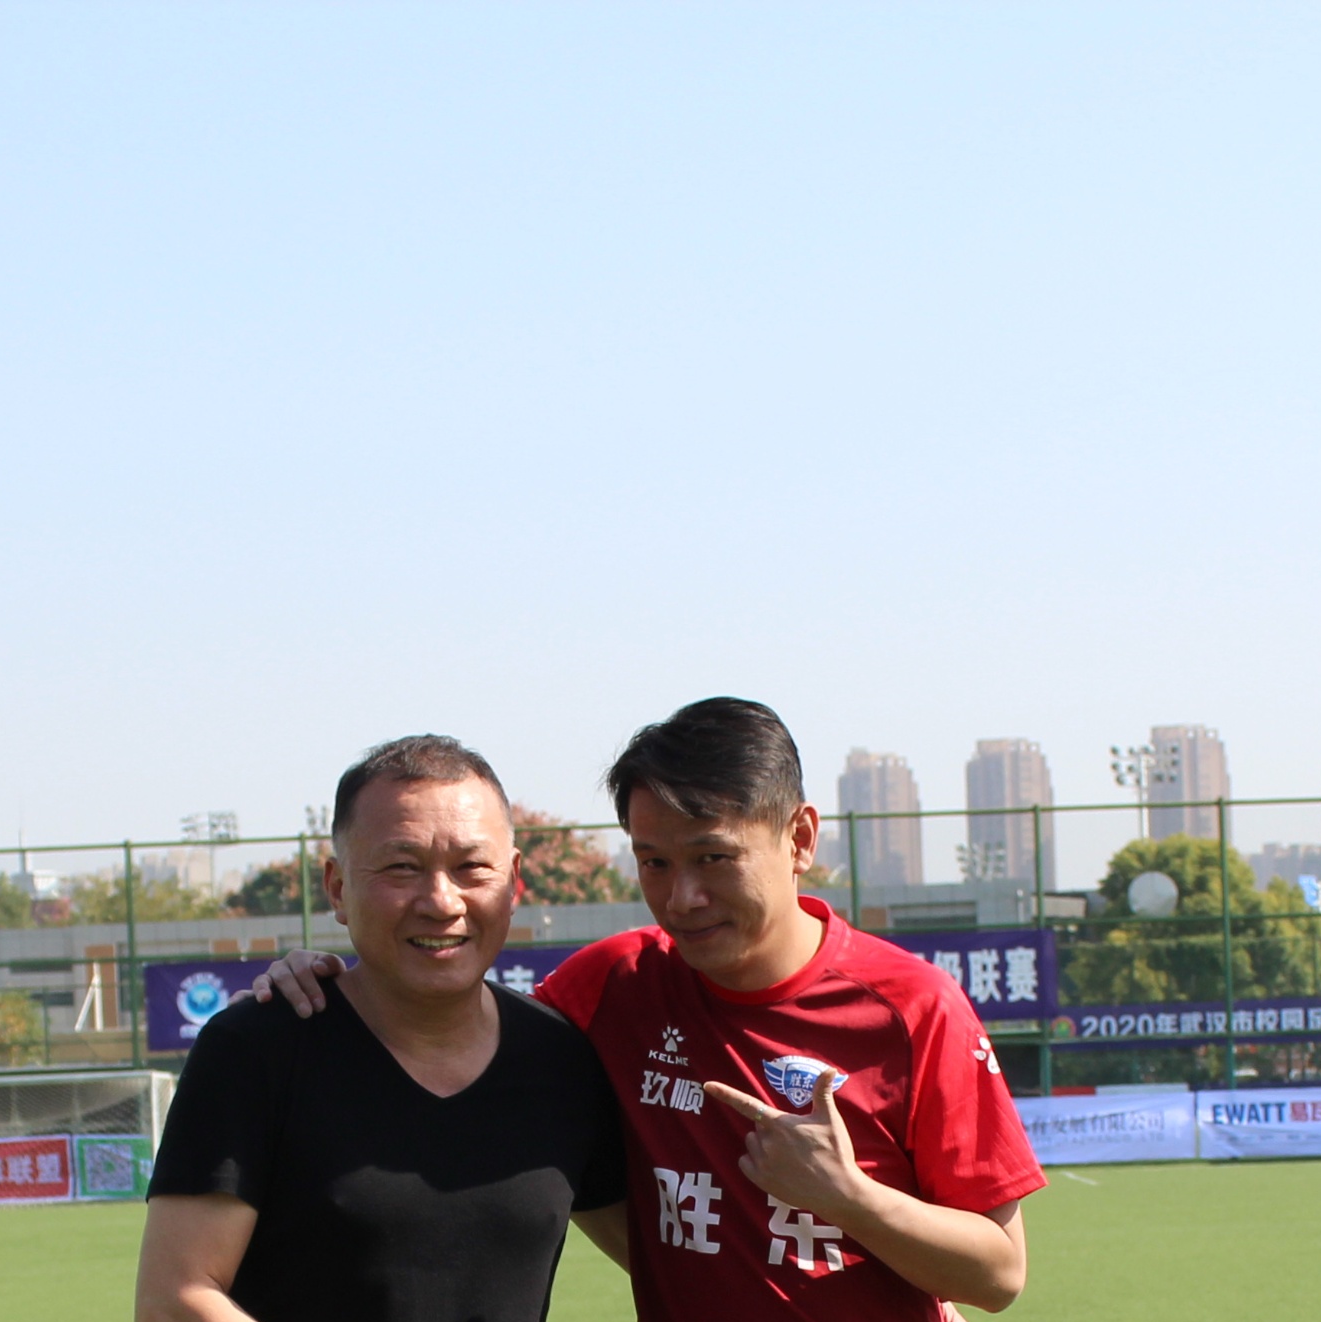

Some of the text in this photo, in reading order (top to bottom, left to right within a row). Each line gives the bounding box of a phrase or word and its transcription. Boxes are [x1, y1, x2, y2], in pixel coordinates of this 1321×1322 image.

[648, 1049, 689, 1067] KELME
[640, 1070, 705, 1115] 玖顺
[1212, 1102, 1287, 1125] EWATT
